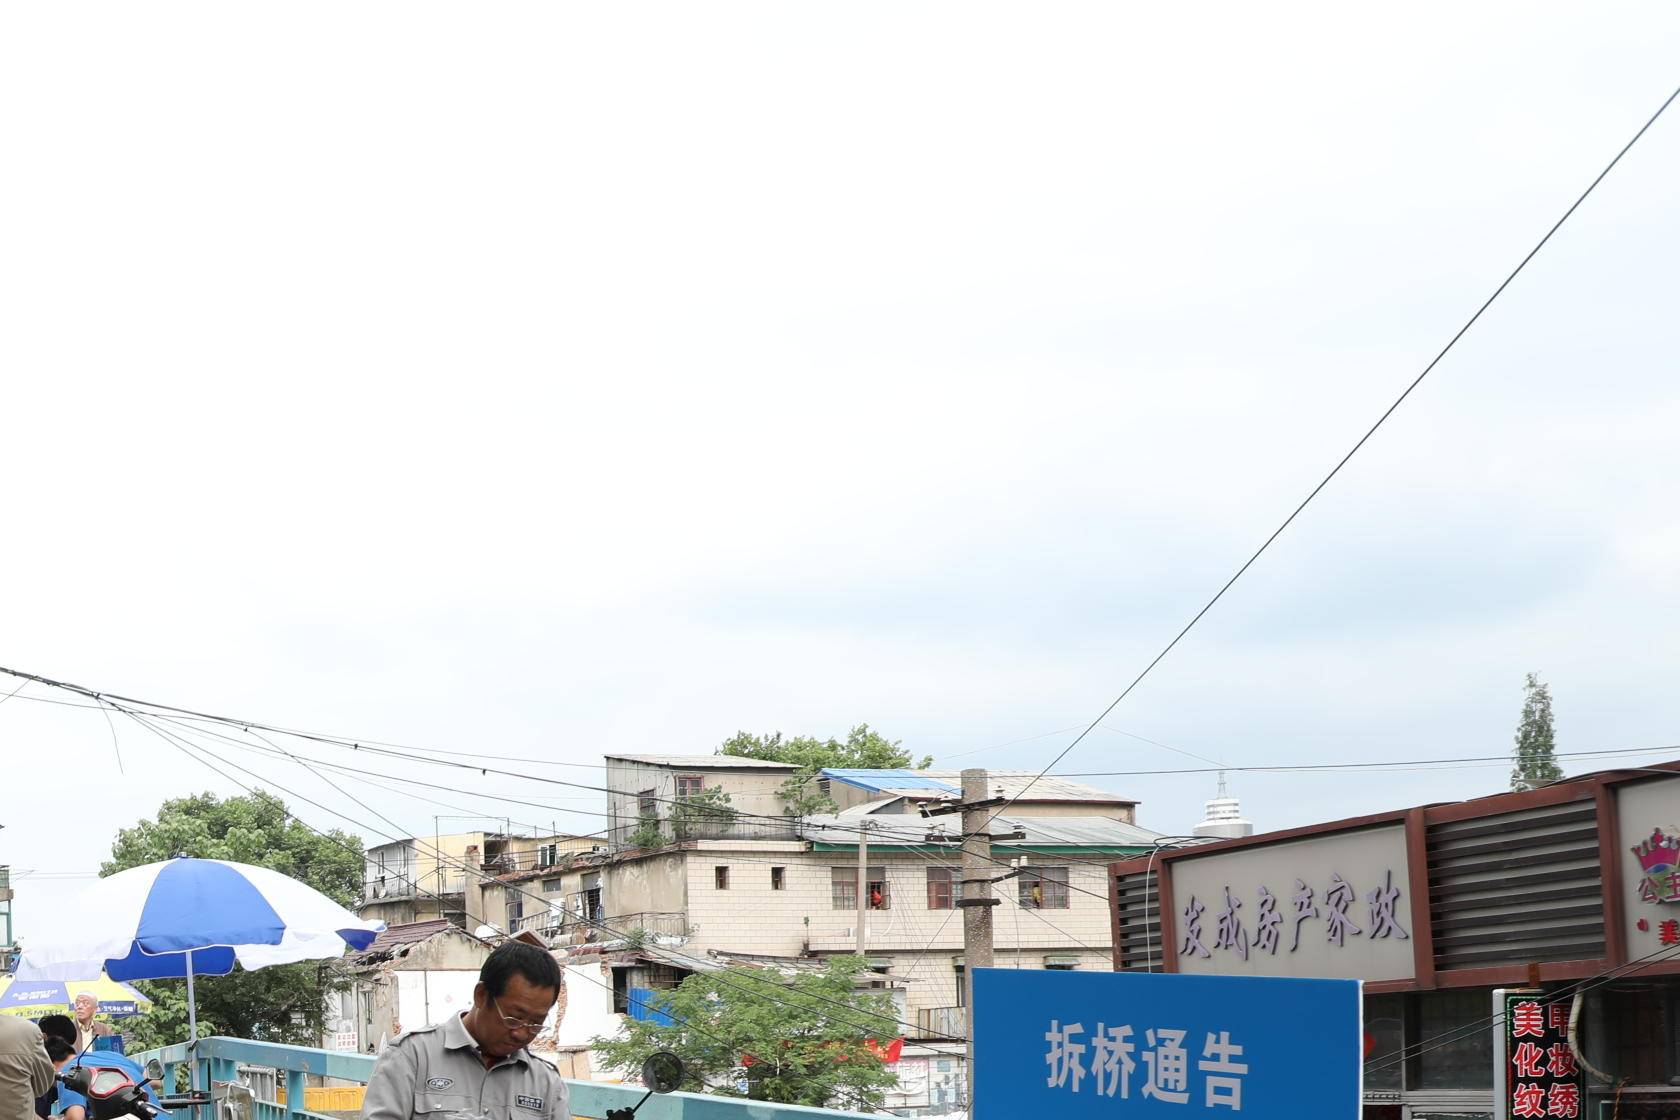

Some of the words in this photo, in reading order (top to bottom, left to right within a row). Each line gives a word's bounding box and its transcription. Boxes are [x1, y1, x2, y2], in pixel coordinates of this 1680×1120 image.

[1513, 1001, 1572, 1037] 美甲
[1045, 1019, 1249, 1111] 拆桥通告
[1513, 1043, 1579, 1077] 化妆
[1513, 1083, 1579, 1118] 纹绣
